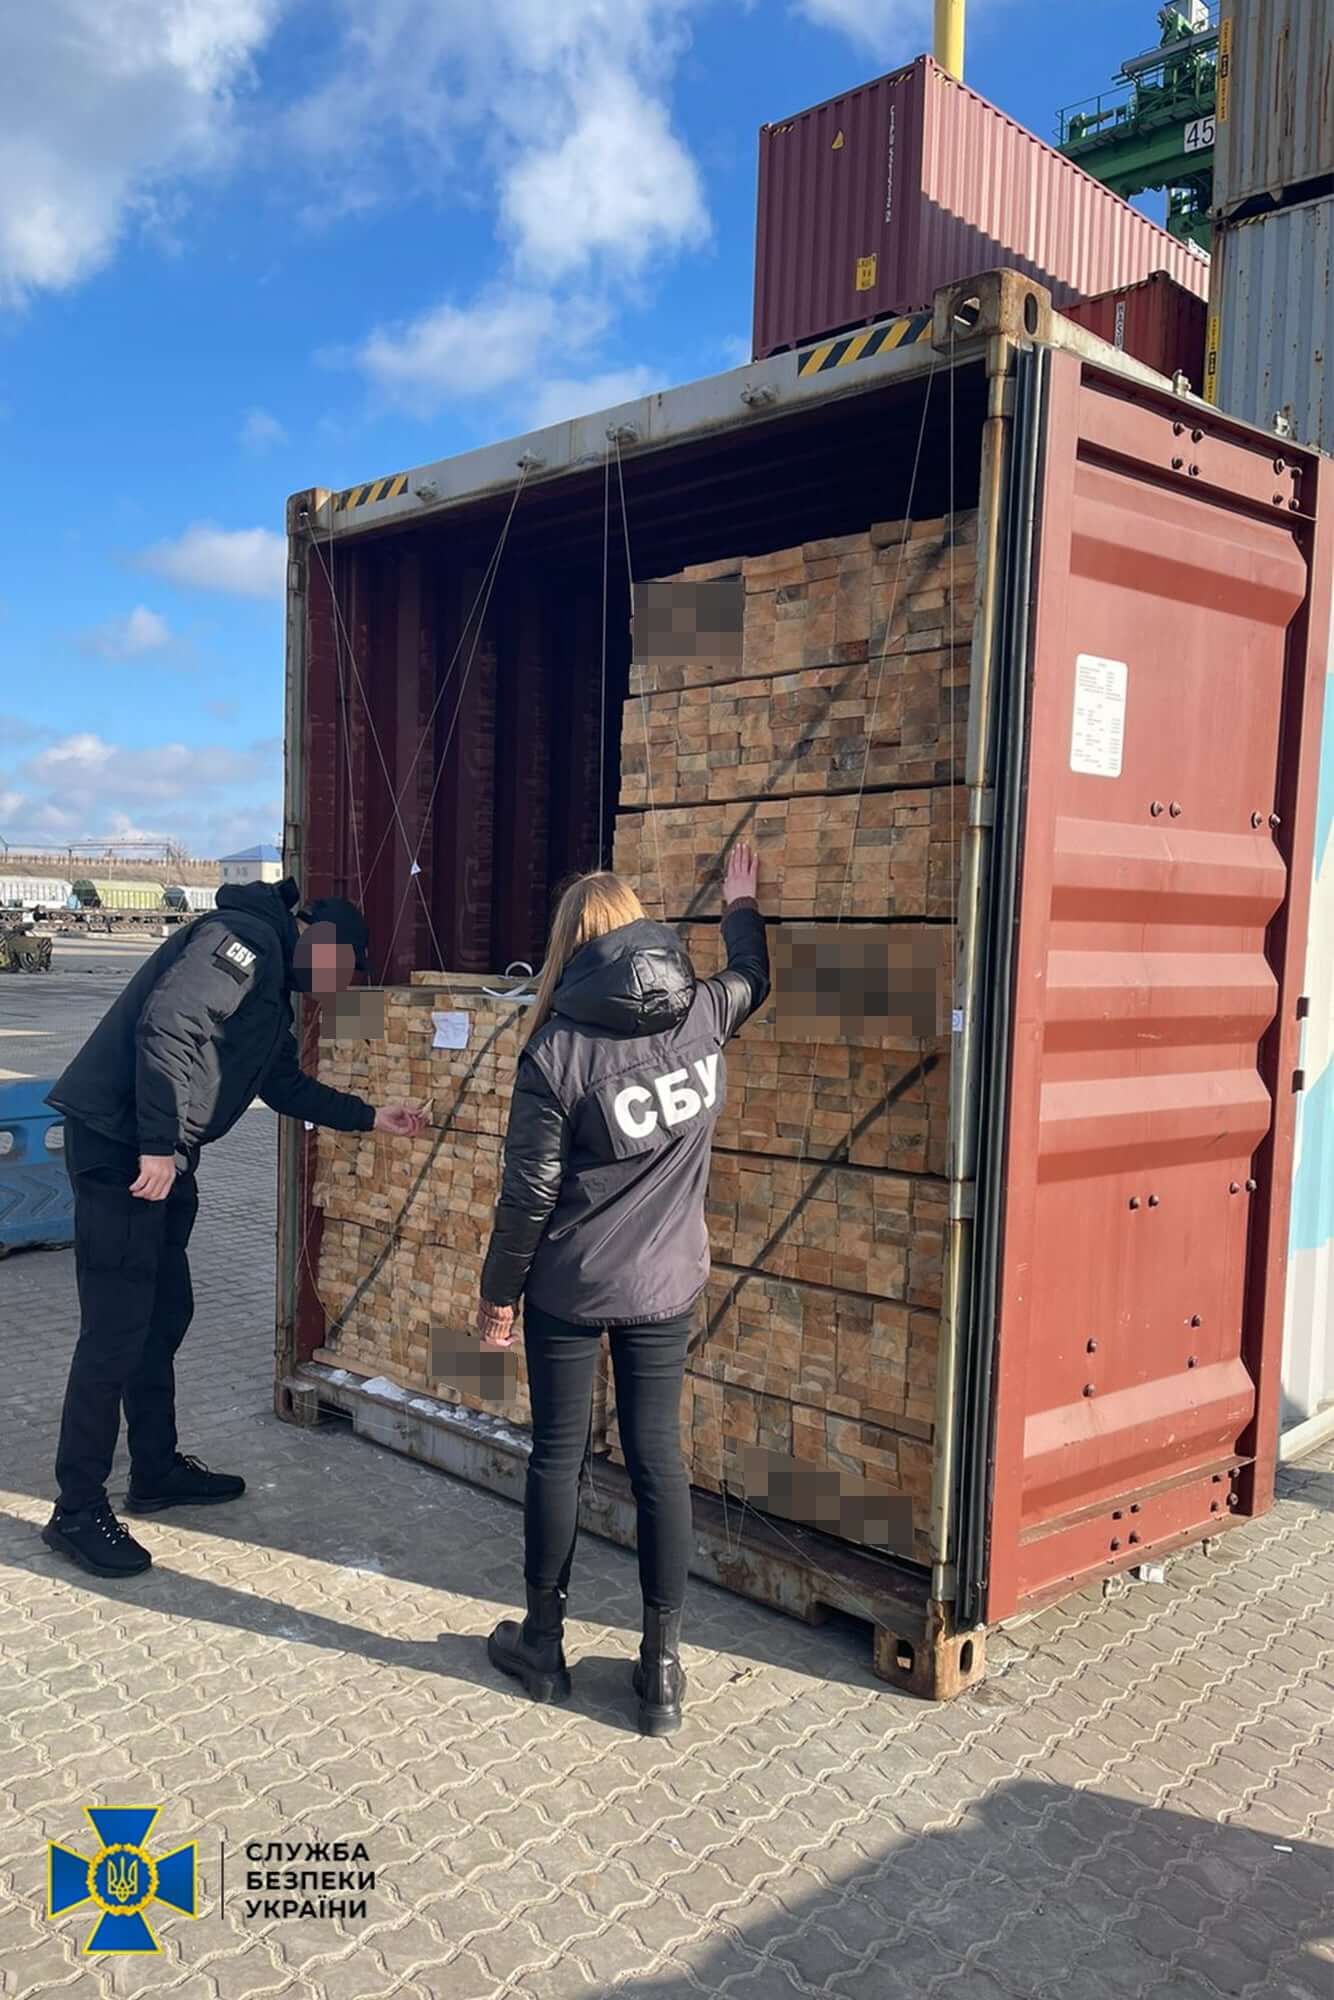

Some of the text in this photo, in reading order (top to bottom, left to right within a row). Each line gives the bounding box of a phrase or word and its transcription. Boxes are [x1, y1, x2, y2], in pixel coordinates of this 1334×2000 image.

[1186, 117, 1214, 147] 45
[226, 942, 257, 967] СБУ
[614, 1053, 719, 1139] СБУ
